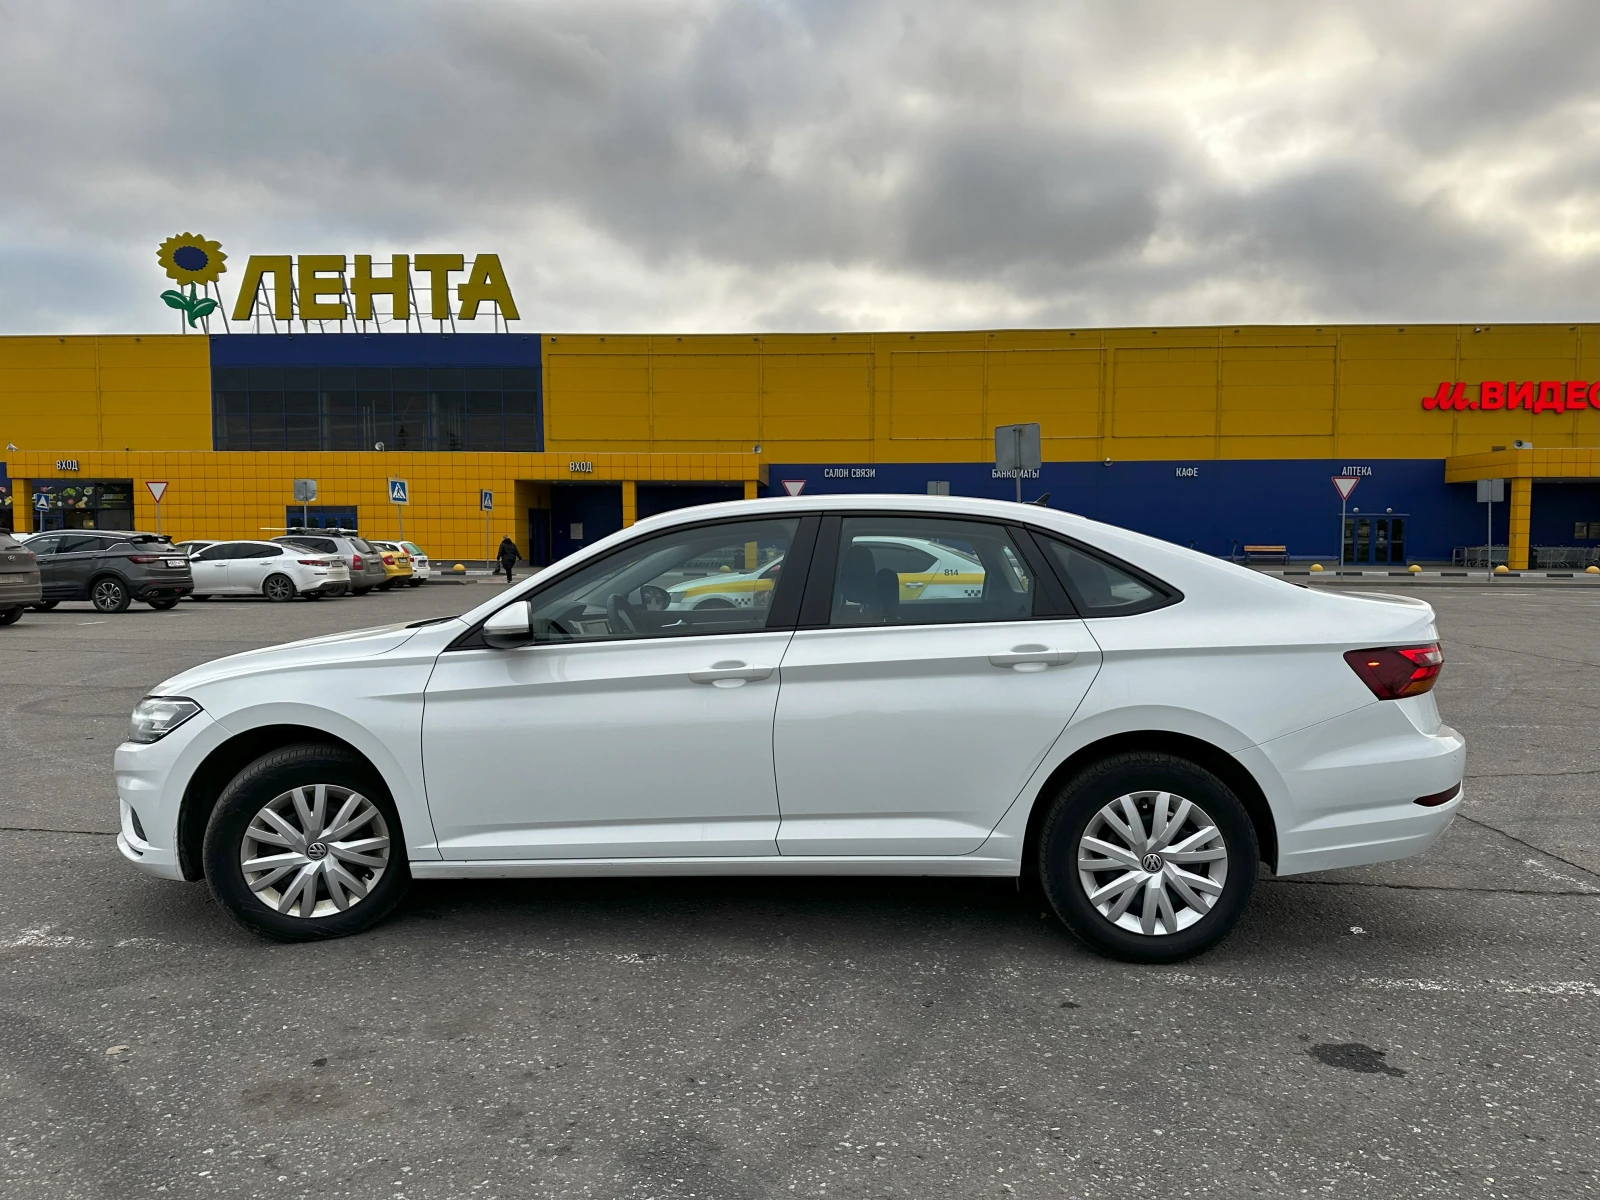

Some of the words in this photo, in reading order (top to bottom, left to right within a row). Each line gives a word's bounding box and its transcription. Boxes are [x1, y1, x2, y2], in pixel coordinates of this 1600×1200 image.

[232, 254, 520, 320] ЛЕНТА
[56, 460, 79, 471] ВХОД
[569, 461, 593, 472] ВХОД
[824, 468, 849, 478] САЛОН
[851, 468, 876, 478] СВЯЗИ
[1175, 467, 1199, 477] КАФЕ
[1341, 466, 1373, 476] АПТЕКА
[944, 568, 959, 577] 814
